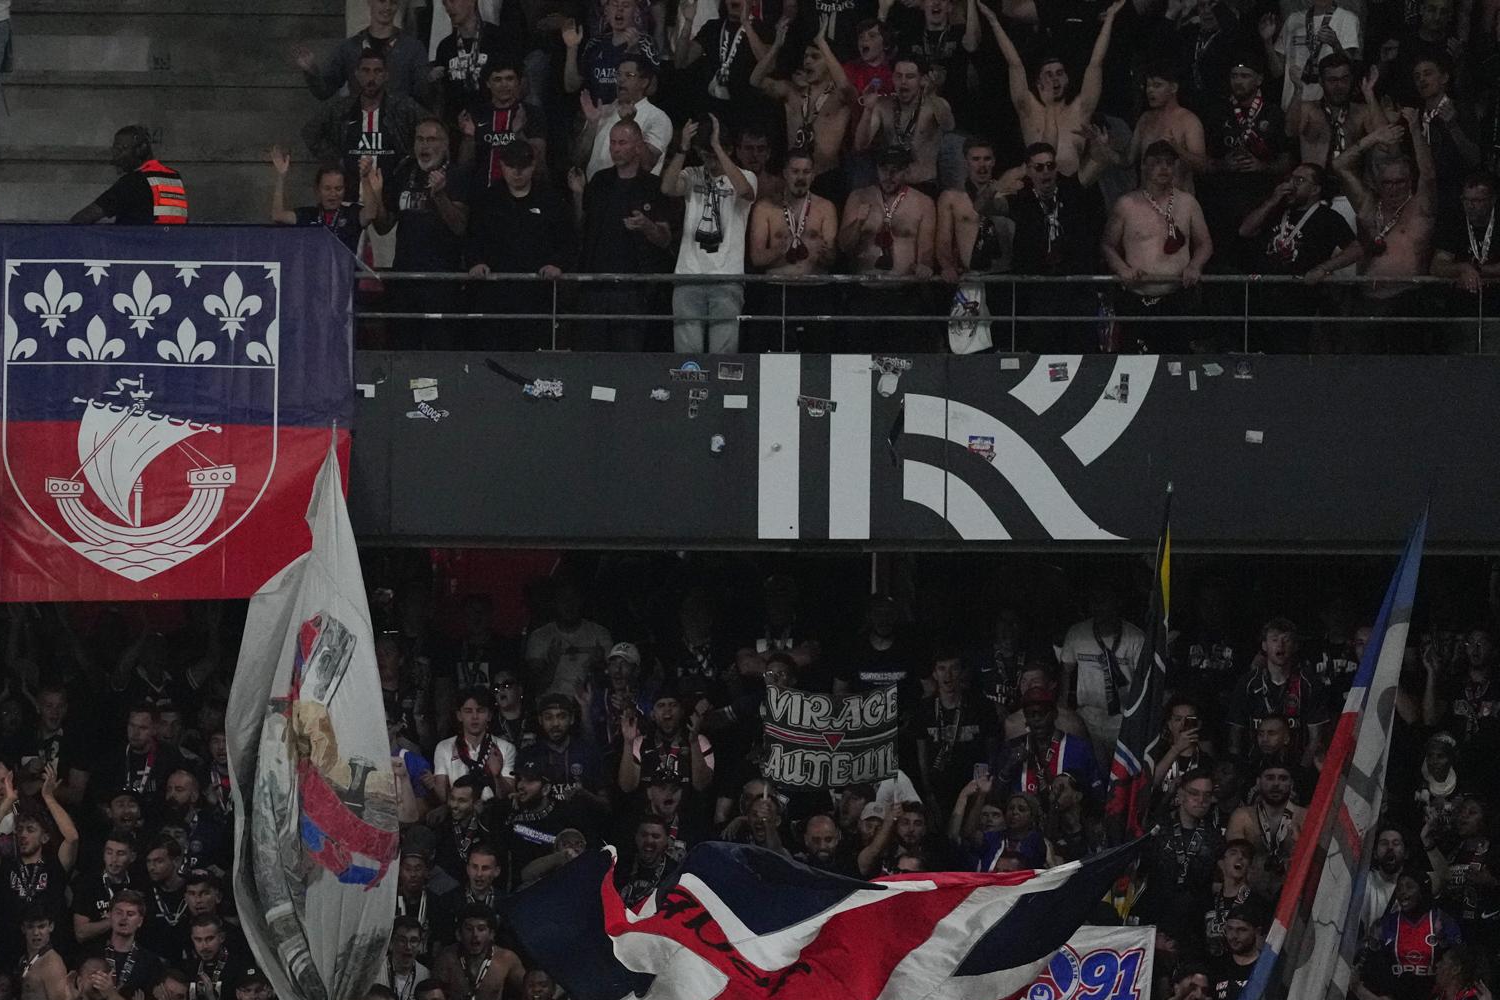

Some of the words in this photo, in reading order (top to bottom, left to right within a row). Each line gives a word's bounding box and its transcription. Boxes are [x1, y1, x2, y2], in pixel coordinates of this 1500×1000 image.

[484, 132, 516, 142] QATAR
[764, 683, 899, 731] VIRAGE
[762, 741, 900, 788] AUTEUIL
